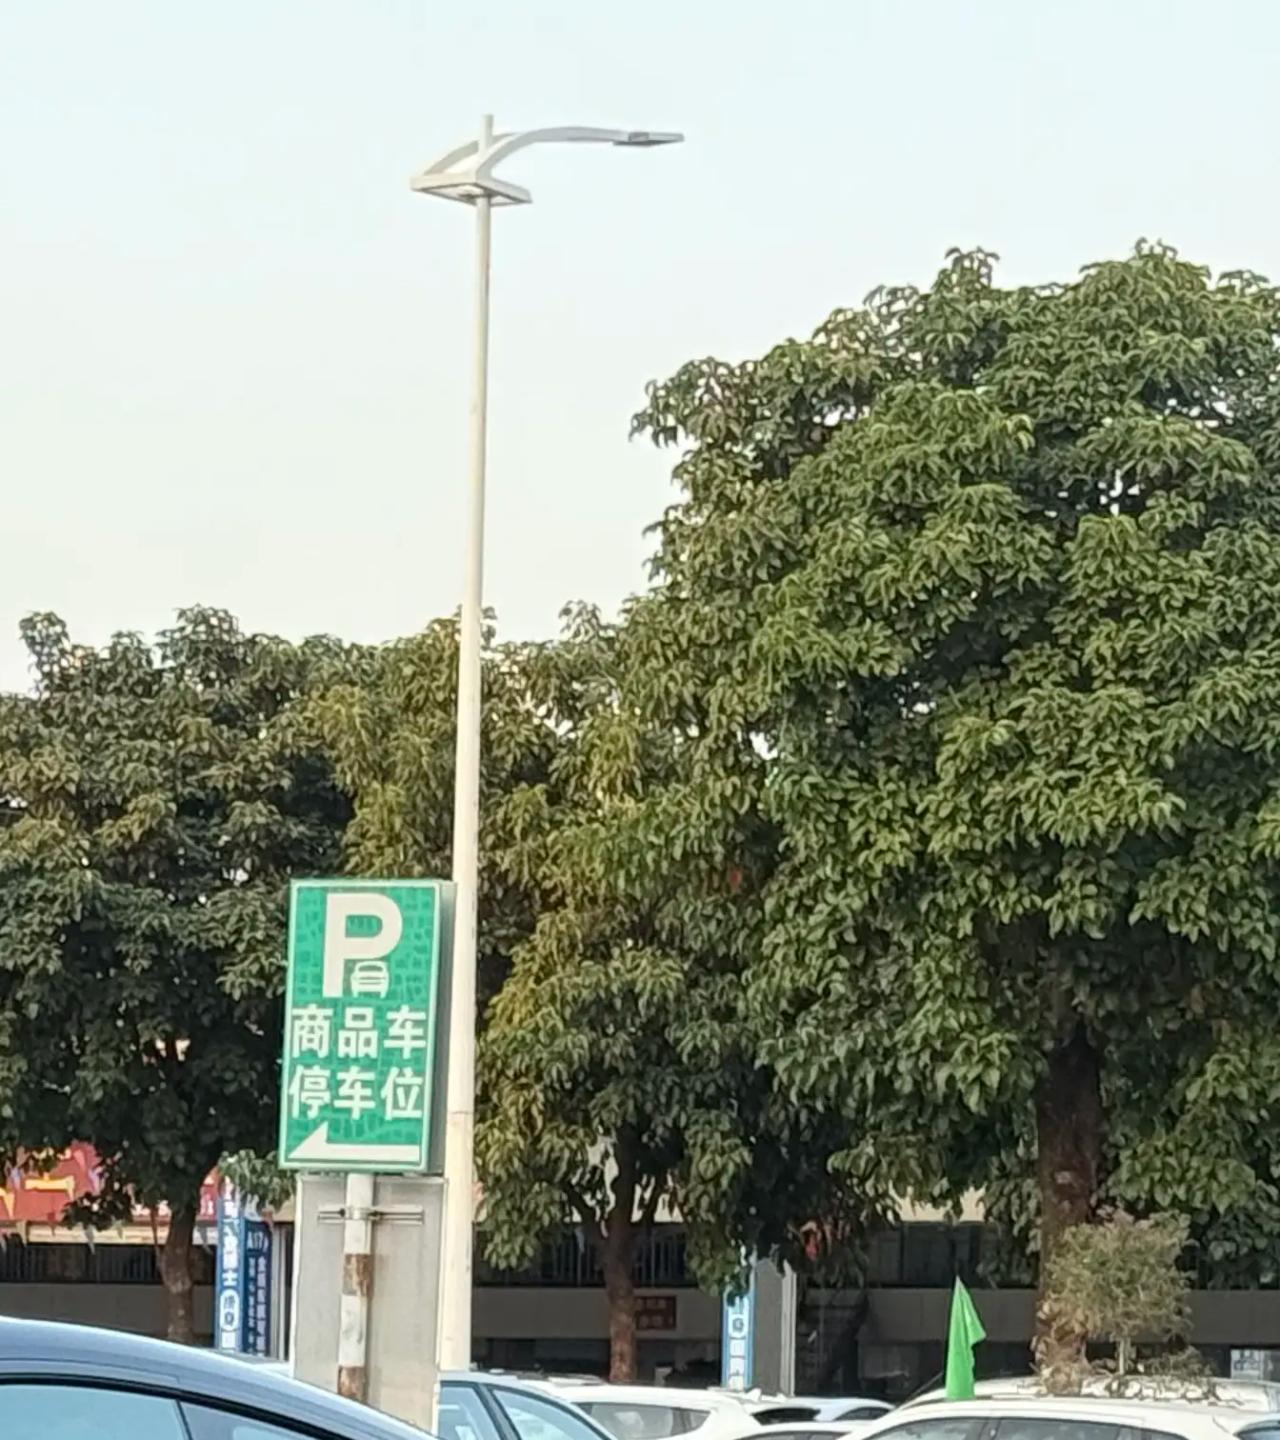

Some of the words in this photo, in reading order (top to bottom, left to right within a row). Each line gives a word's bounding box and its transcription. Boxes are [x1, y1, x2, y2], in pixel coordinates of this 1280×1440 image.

[322, 892, 403, 998] P
[291, 1003, 427, 1060] 商品车
[288, 1064, 424, 1121] 停车位
